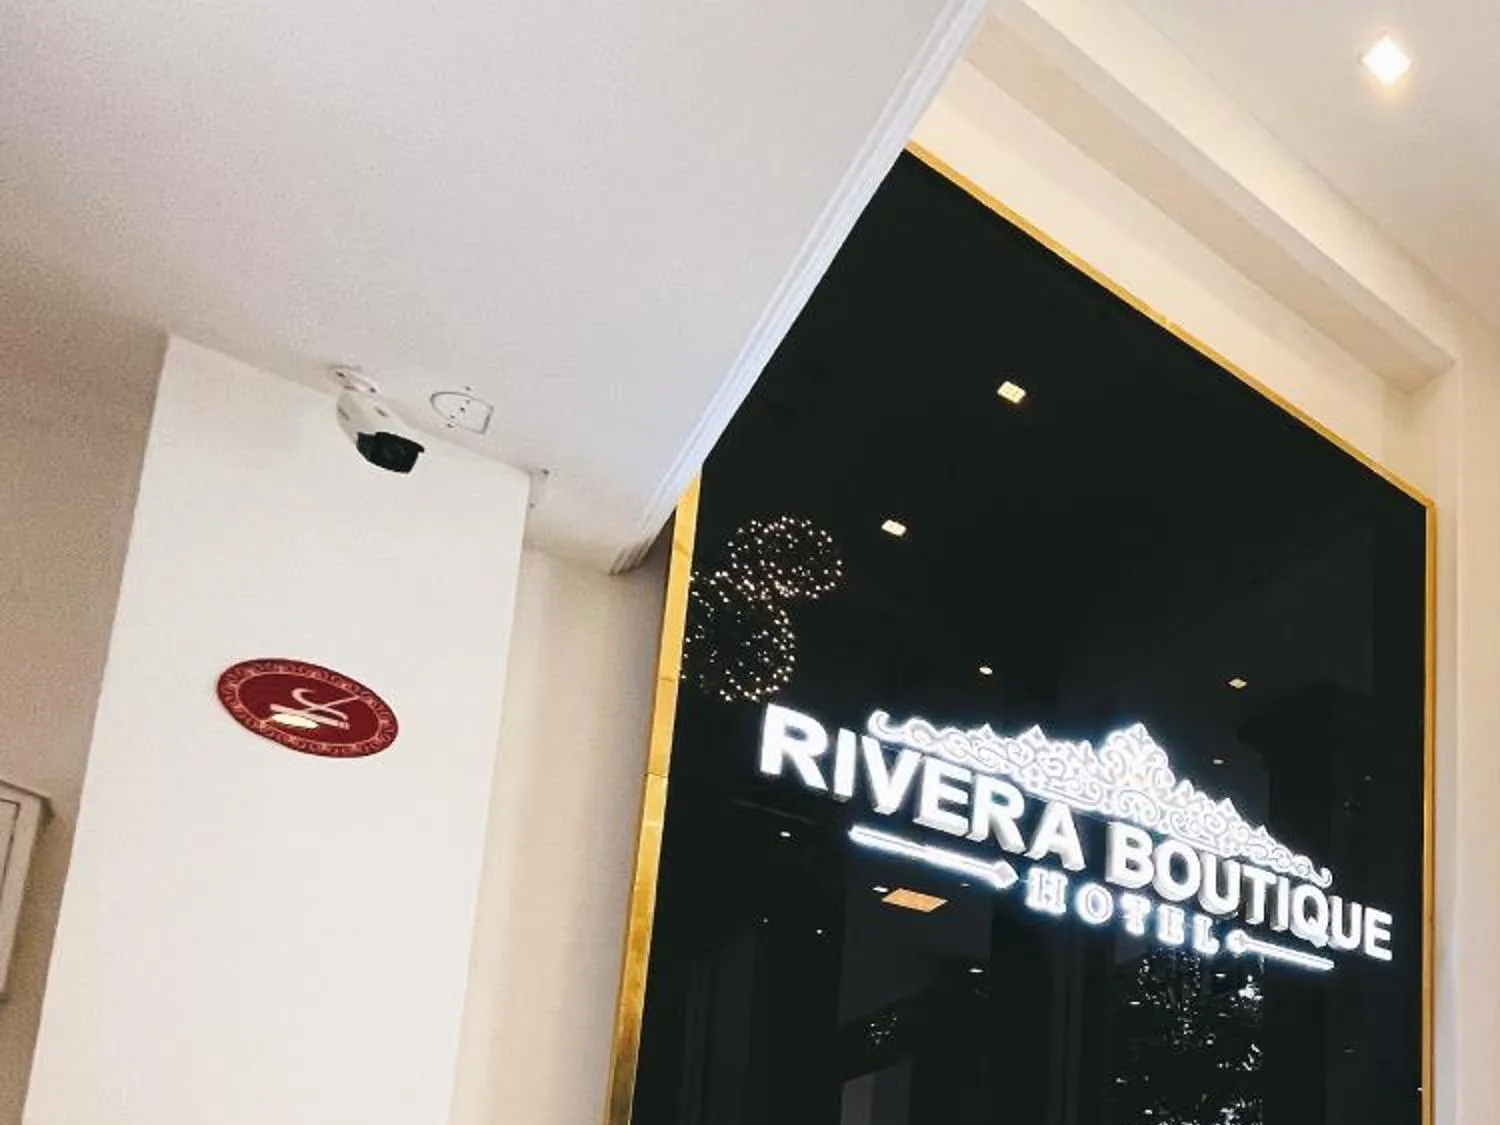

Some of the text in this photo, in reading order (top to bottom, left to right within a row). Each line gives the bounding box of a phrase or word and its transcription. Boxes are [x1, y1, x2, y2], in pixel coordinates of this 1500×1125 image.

[759, 703, 1393, 960] RIVERA BOUTIQUE
[1024, 866, 1220, 955] HOTEL
